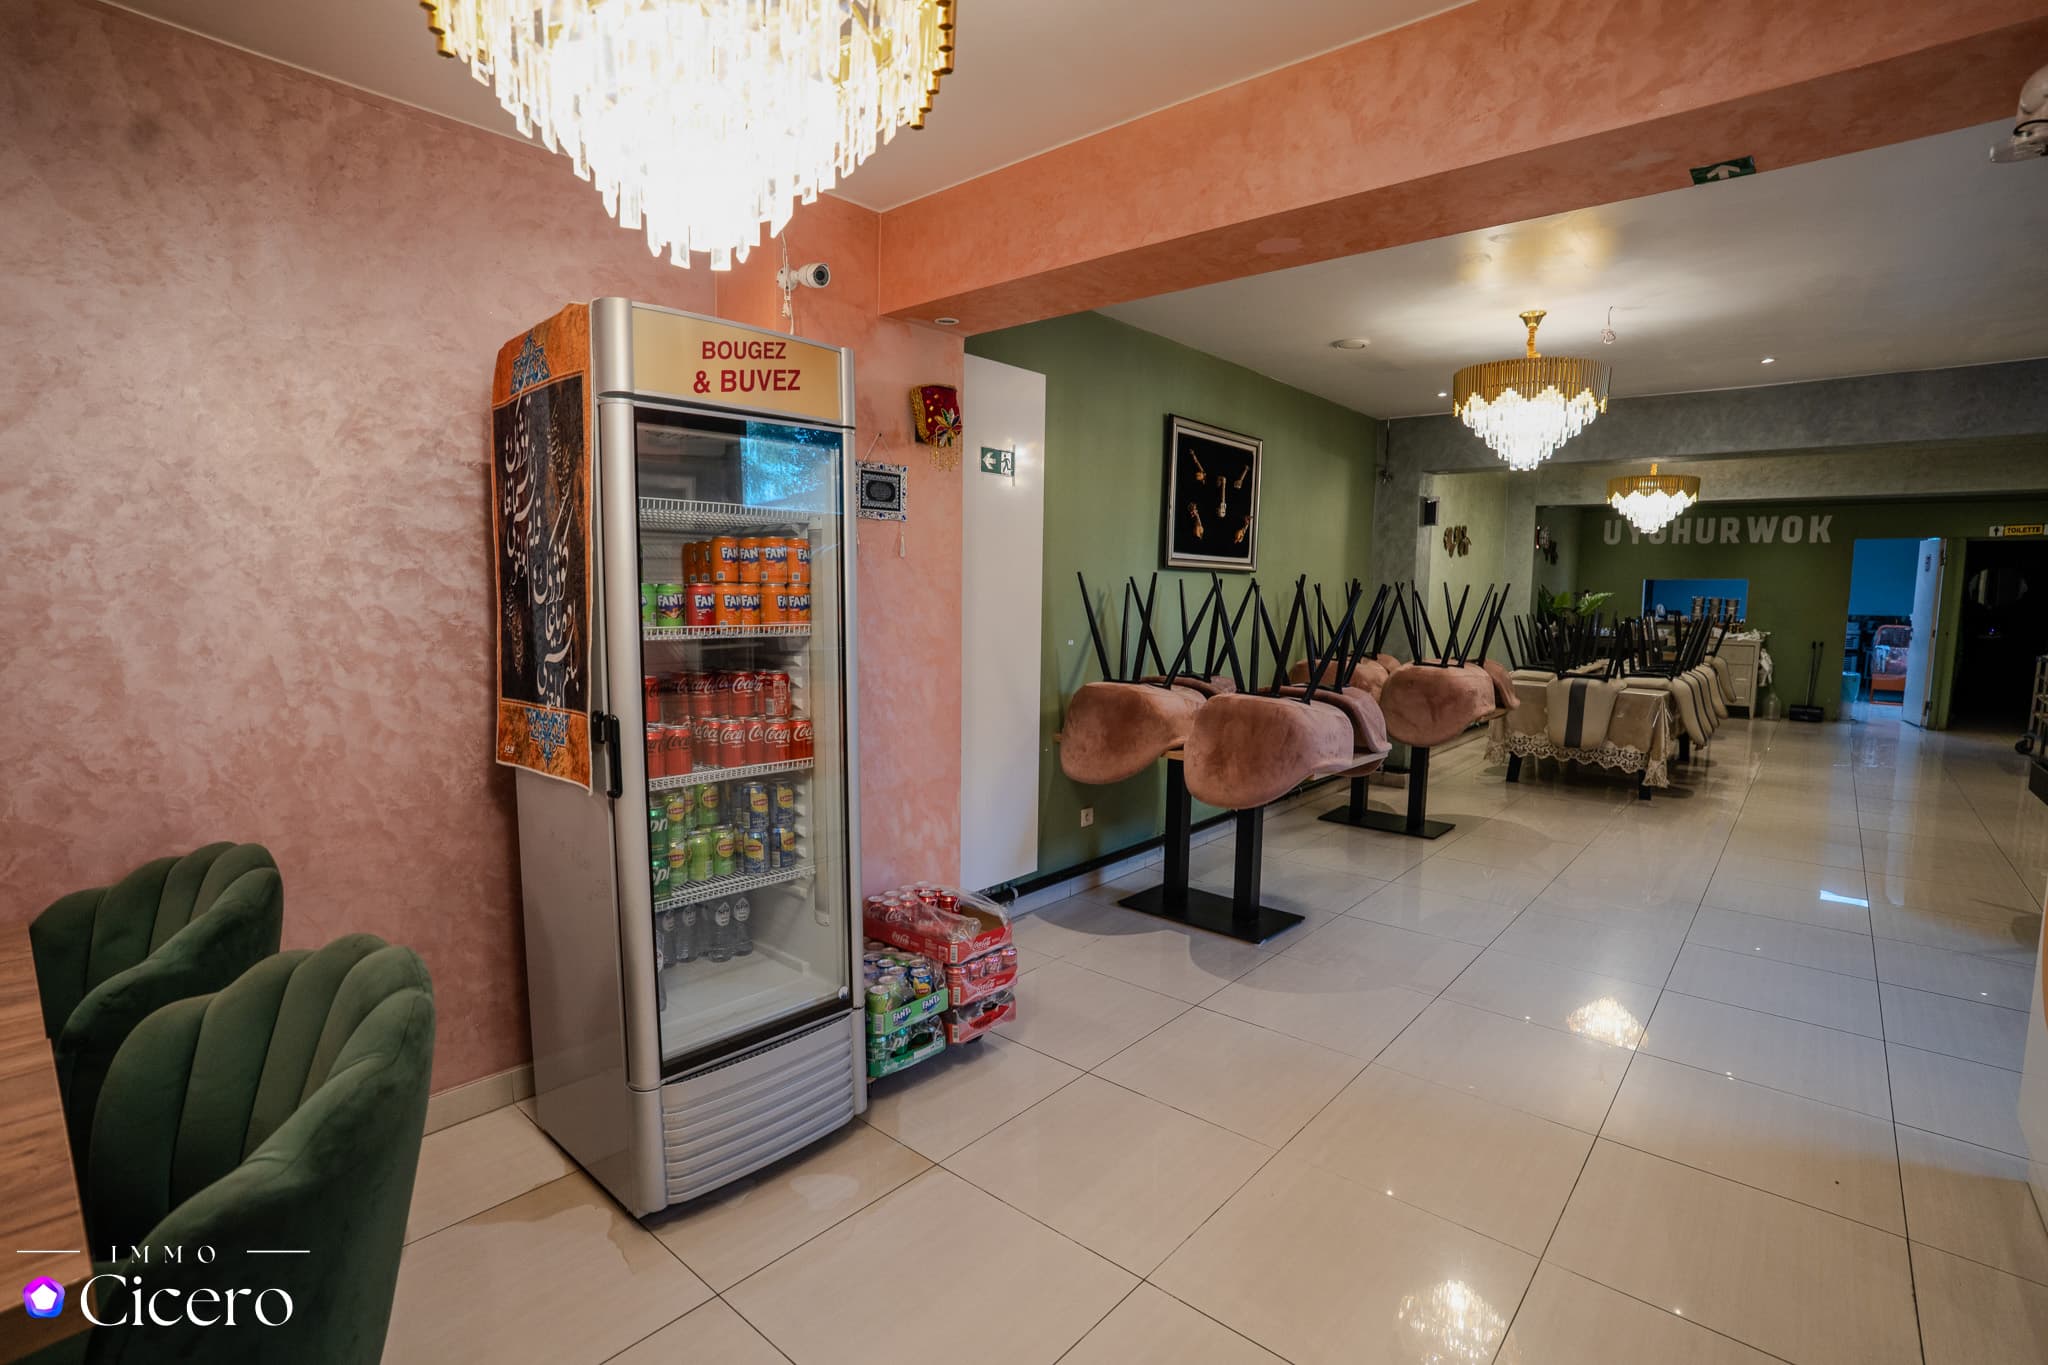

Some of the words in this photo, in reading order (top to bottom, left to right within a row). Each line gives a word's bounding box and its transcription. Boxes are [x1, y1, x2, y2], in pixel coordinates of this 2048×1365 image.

[702, 341, 786, 360] BOUGEZ
[693, 370, 711, 394] &
[720, 369, 801, 392] BUVEZ
[921, 995, 941, 1010] FANTA
[891, 1008, 912, 1023] FANTA
